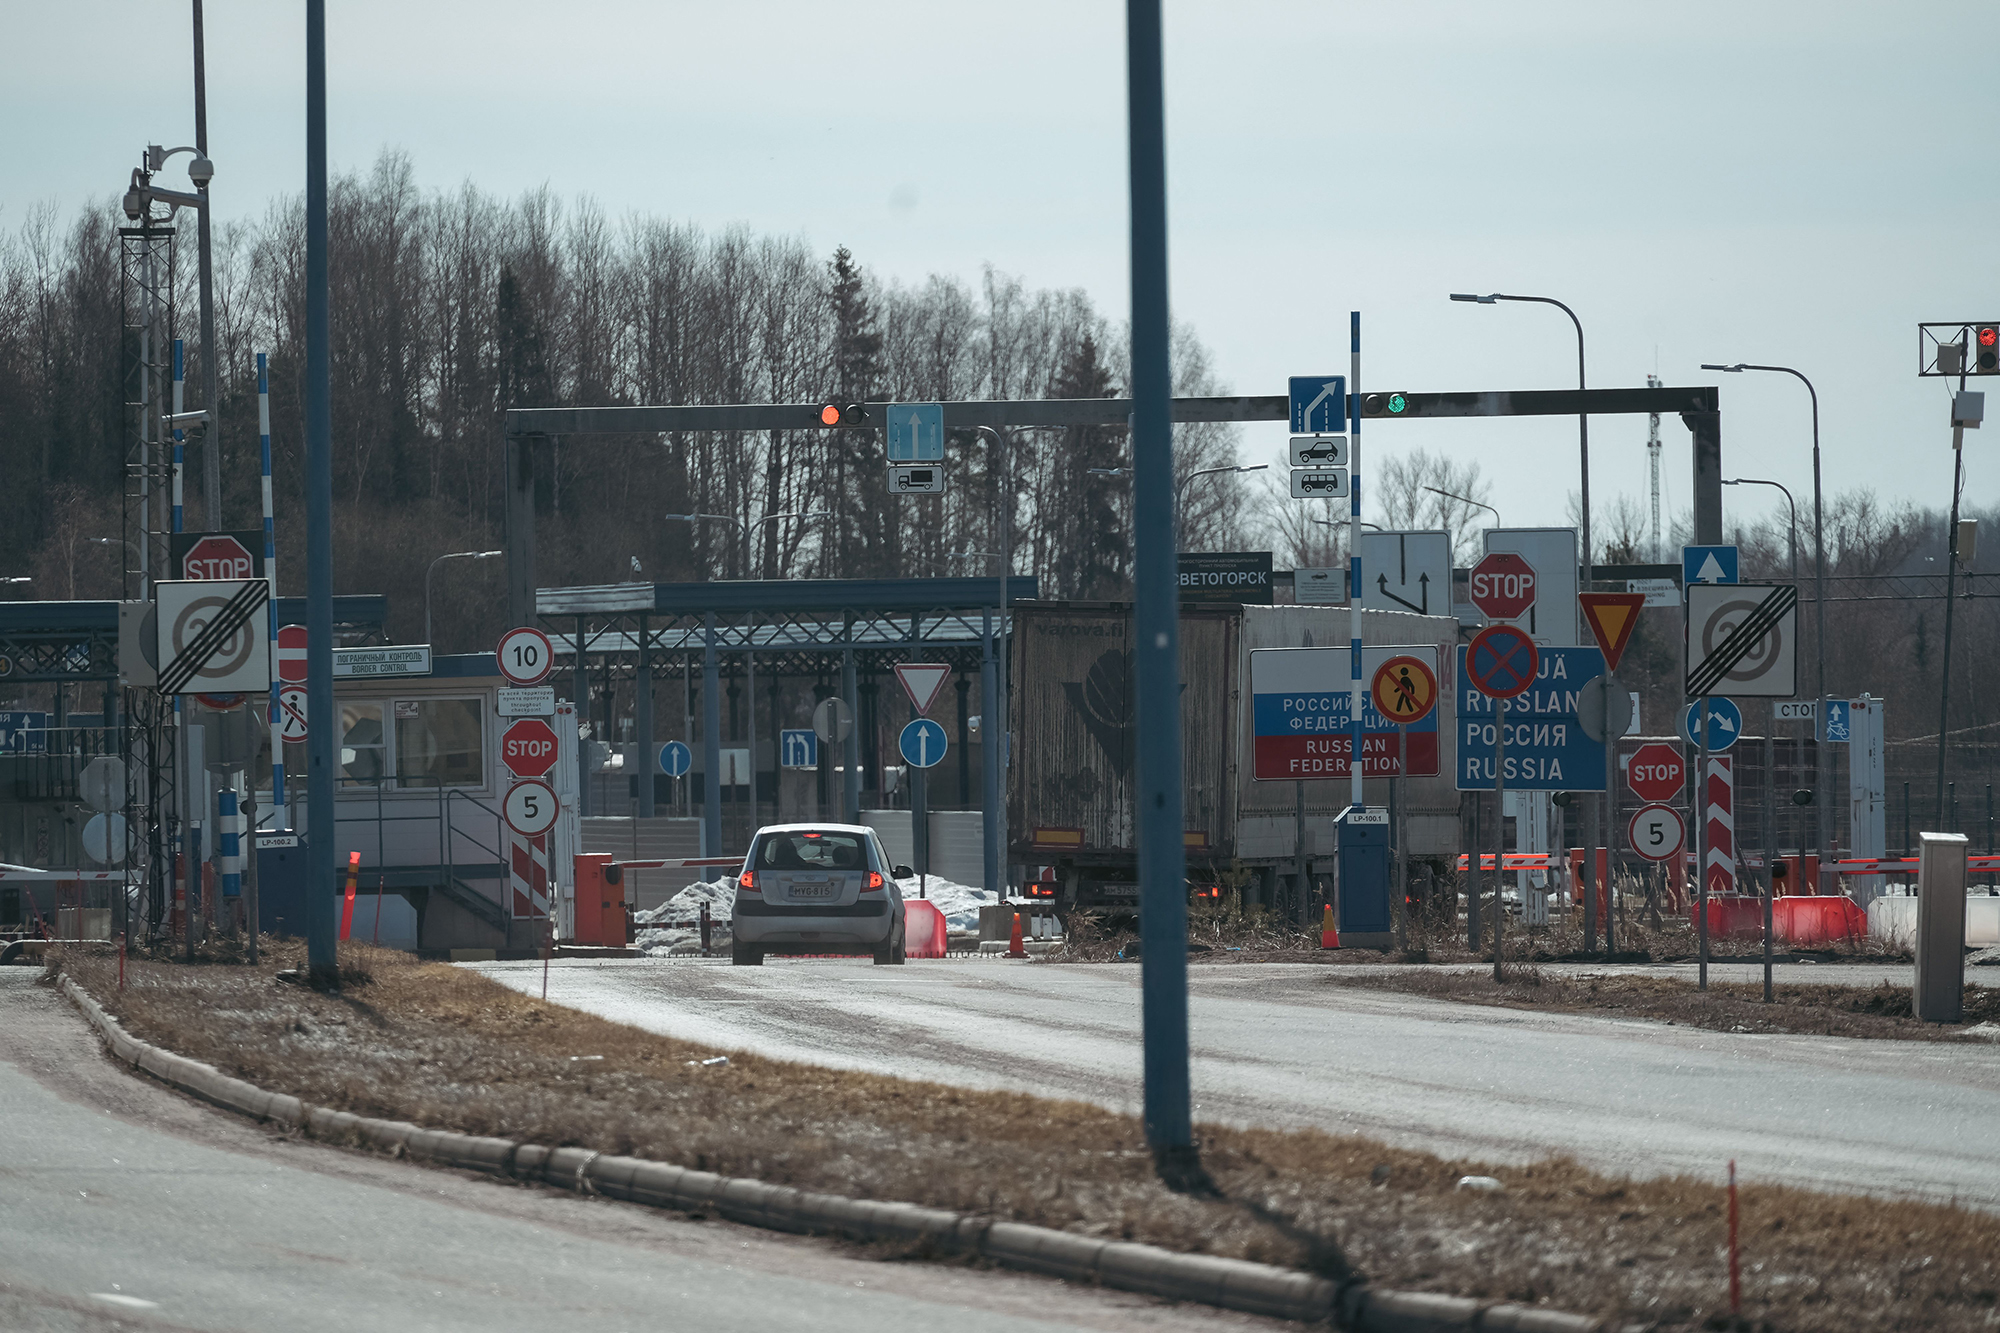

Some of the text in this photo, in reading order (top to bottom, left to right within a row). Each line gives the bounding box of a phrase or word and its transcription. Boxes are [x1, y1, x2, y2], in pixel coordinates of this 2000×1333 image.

[188, 557, 249, 579] STOP
[1473, 573, 1534, 599] STOP
[1037, 622, 1123, 637] varova.fi
[337, 651, 422, 663] ПОГРАНИЧНЫЙ КОНТРОЛЬ
[513, 645, 538, 667] 10
[352, 663, 408, 673] BORDER CONTROL
[1283, 694, 1374, 712] РОССИЙС
[1289, 715, 1401, 732] ФЕДЕРЦИ
[1466, 723, 1567, 747] РОССИЯ
[507, 739, 552, 757] STOP
[1306, 738, 1386, 754] RUSSAN
[1466, 757, 1563, 780] RUSSIA
[1634, 764, 1680, 782] STOP
[524, 796, 539, 818] 5
[261, 838, 292, 846] LP-100.2
[1649, 823, 1664, 845] 5
[794, 887, 831, 896] MVG-815
